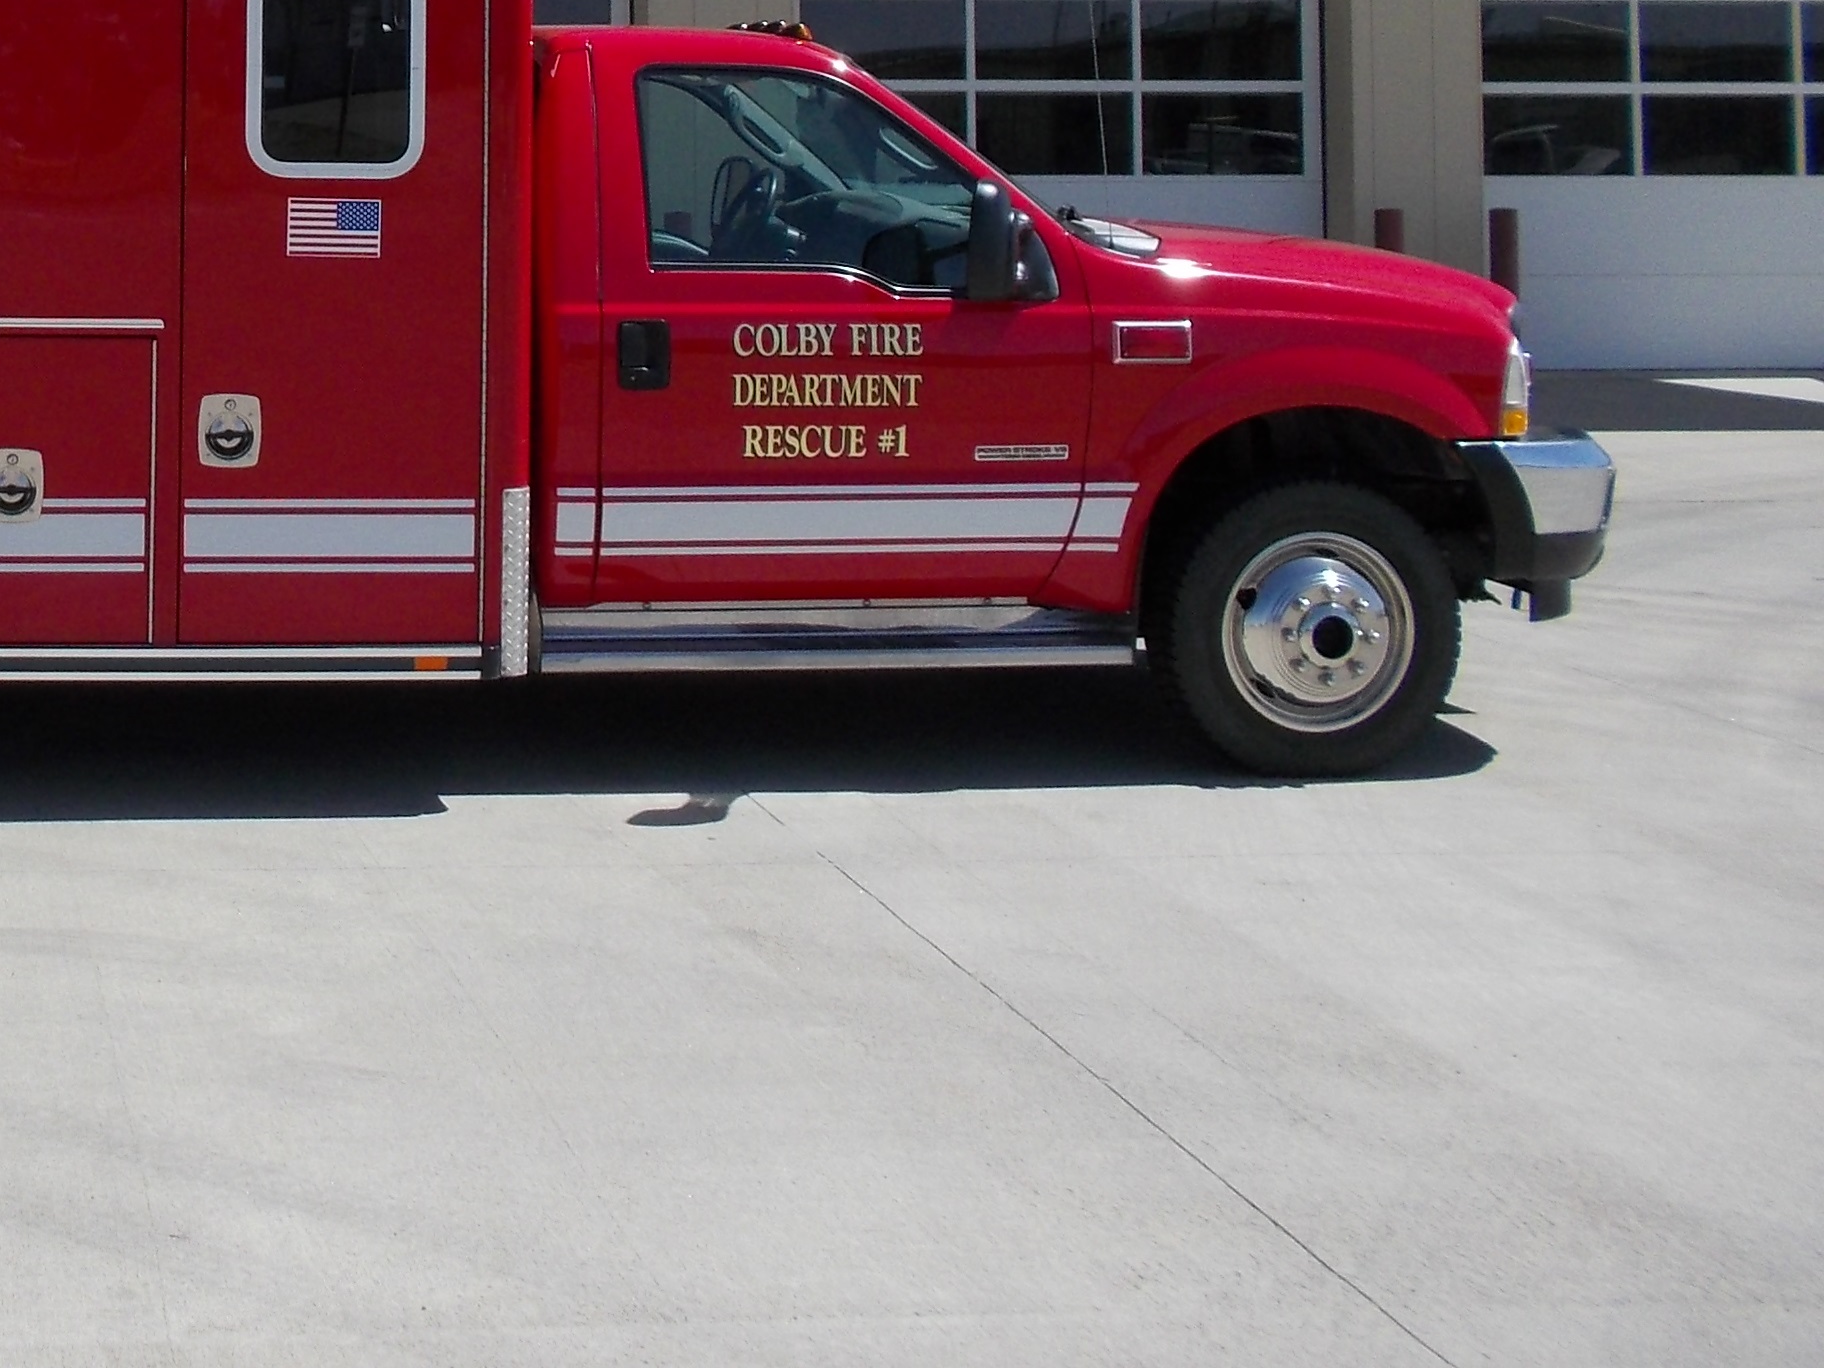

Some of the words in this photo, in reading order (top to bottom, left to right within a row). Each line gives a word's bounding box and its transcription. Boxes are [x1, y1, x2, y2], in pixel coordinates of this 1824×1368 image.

[733, 323, 836, 357] COLBY
[849, 323, 924, 356] FIRE
[733, 373, 923, 407] DEPARTMENT
[743, 424, 867, 458] RESCUE
[878, 424, 910, 457] #1
